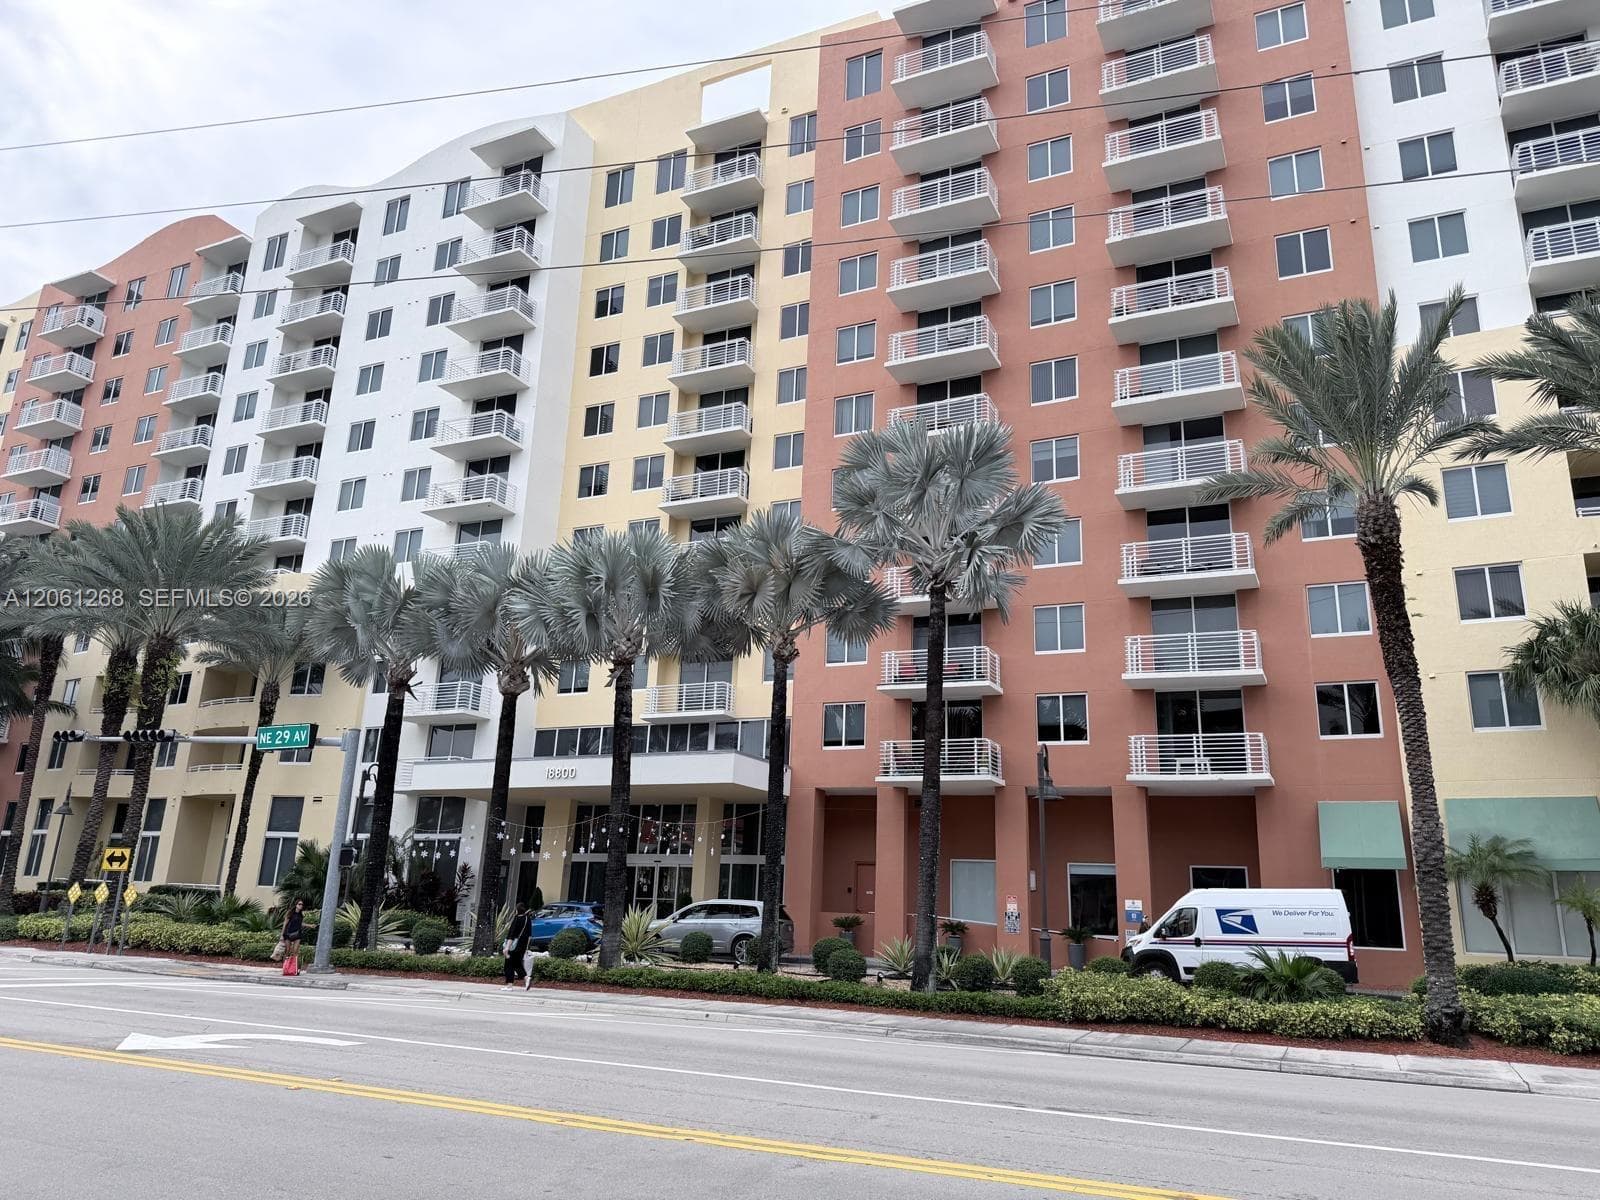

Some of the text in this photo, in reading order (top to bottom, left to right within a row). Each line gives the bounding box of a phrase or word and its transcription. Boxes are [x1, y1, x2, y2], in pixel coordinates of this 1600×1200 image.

[260, 730, 307, 744] NE 29 AV
[545, 767, 577, 779] 18800
